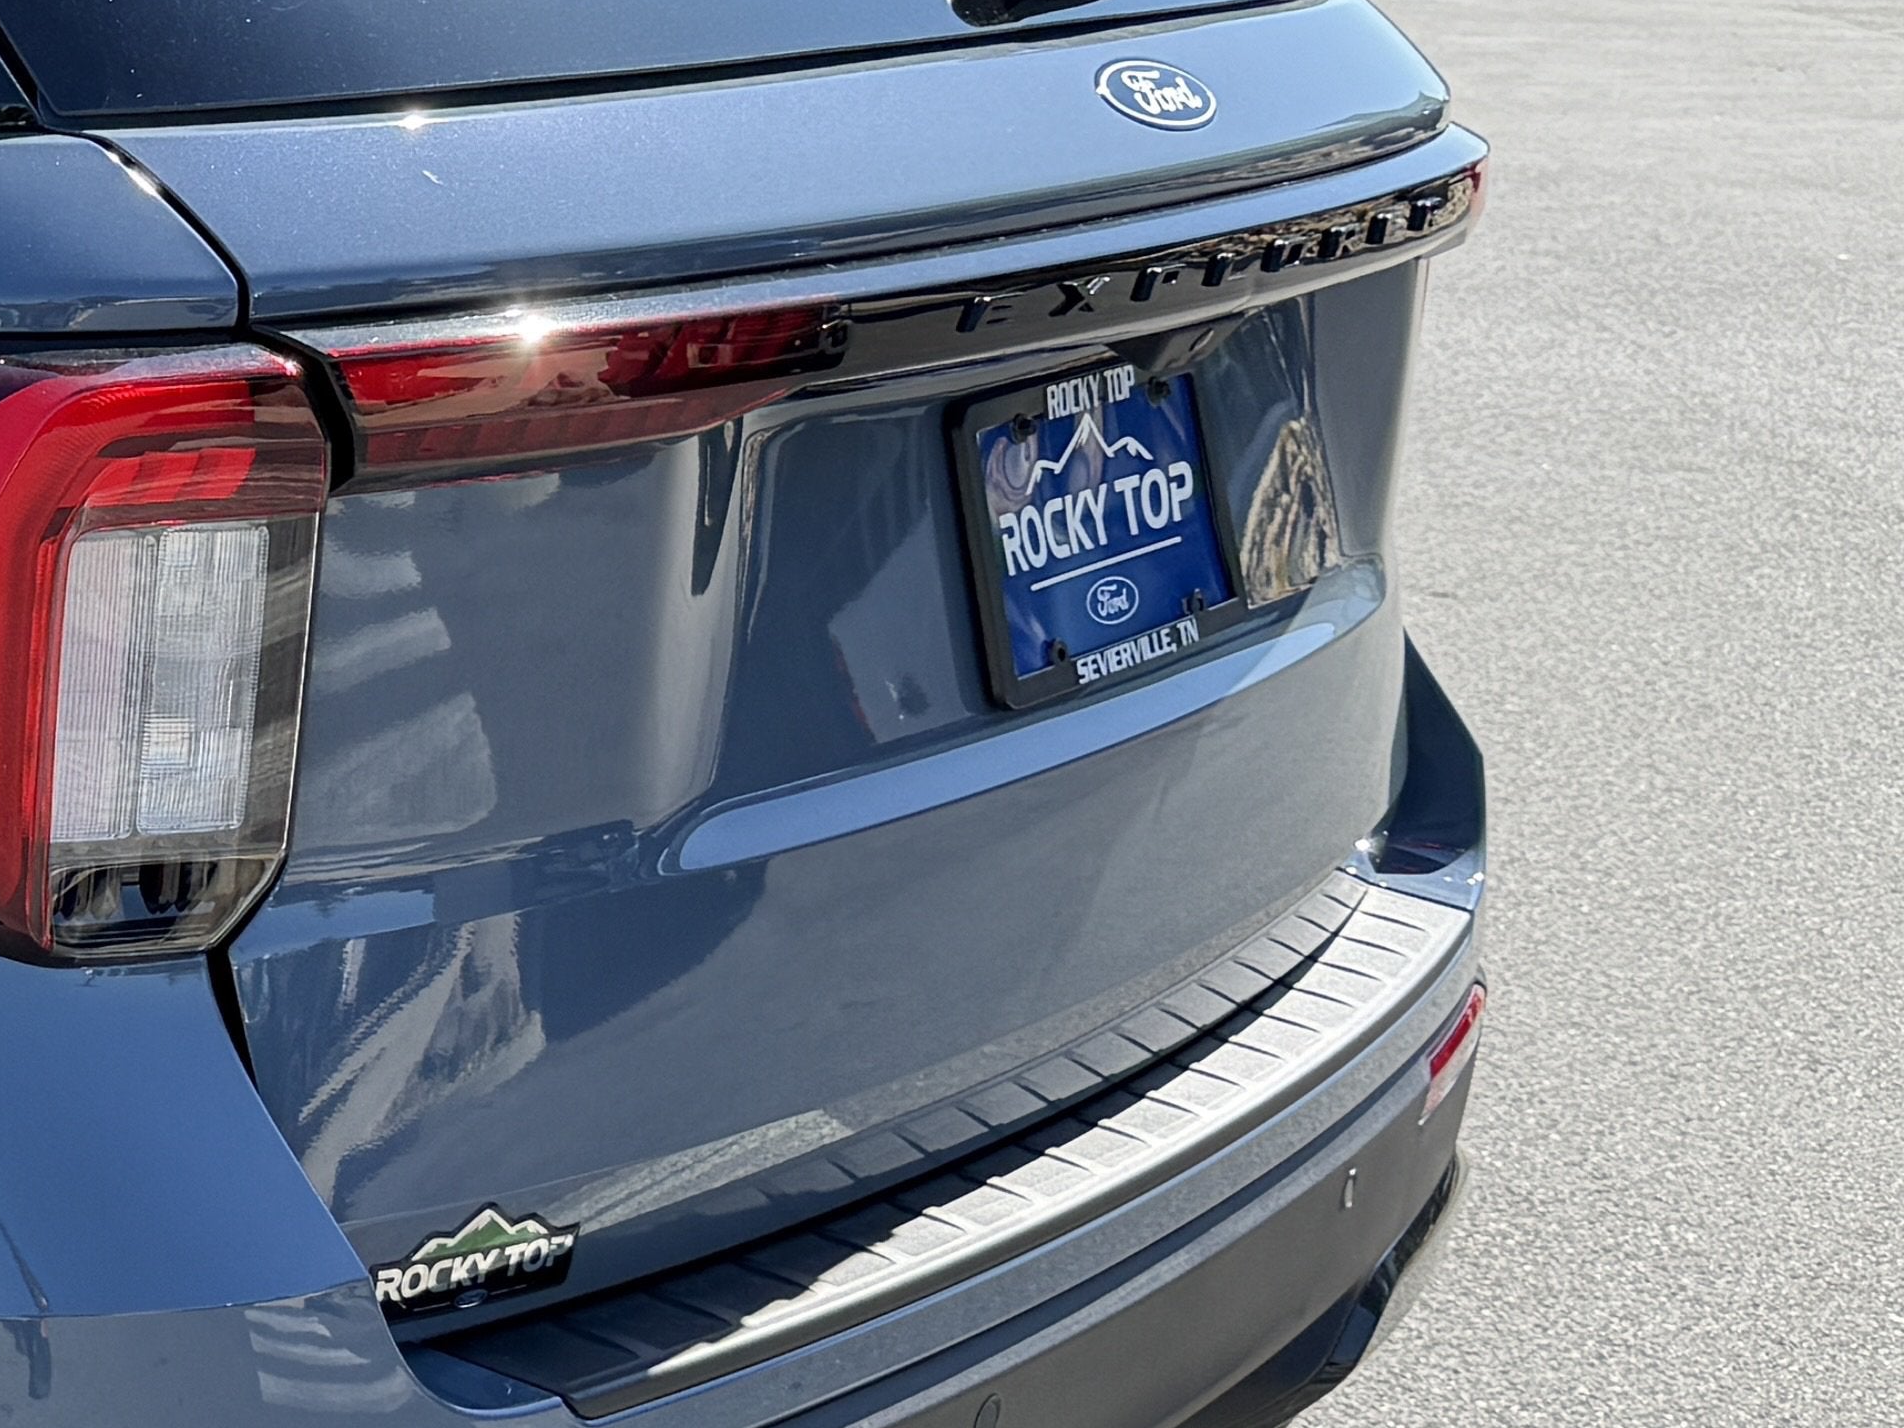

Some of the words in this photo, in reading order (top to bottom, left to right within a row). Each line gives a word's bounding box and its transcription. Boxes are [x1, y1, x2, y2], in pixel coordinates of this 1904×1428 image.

[1120, 70, 1203, 115] Ford
[955, 195, 1444, 333] EXPLORER
[1046, 374, 1100, 420] ROCKY
[1104, 364, 1136, 404] TOP
[998, 483, 1109, 577] ROCKY
[1114, 460, 1193, 537] TOP
[1096, 583, 1130, 618] Ford
[1076, 627, 1177, 685] SEVIERVILLE,
[1177, 618, 1200, 645] TN
[375, 1248, 501, 1303] ROCKY
[504, 1233, 574, 1277] TOP
